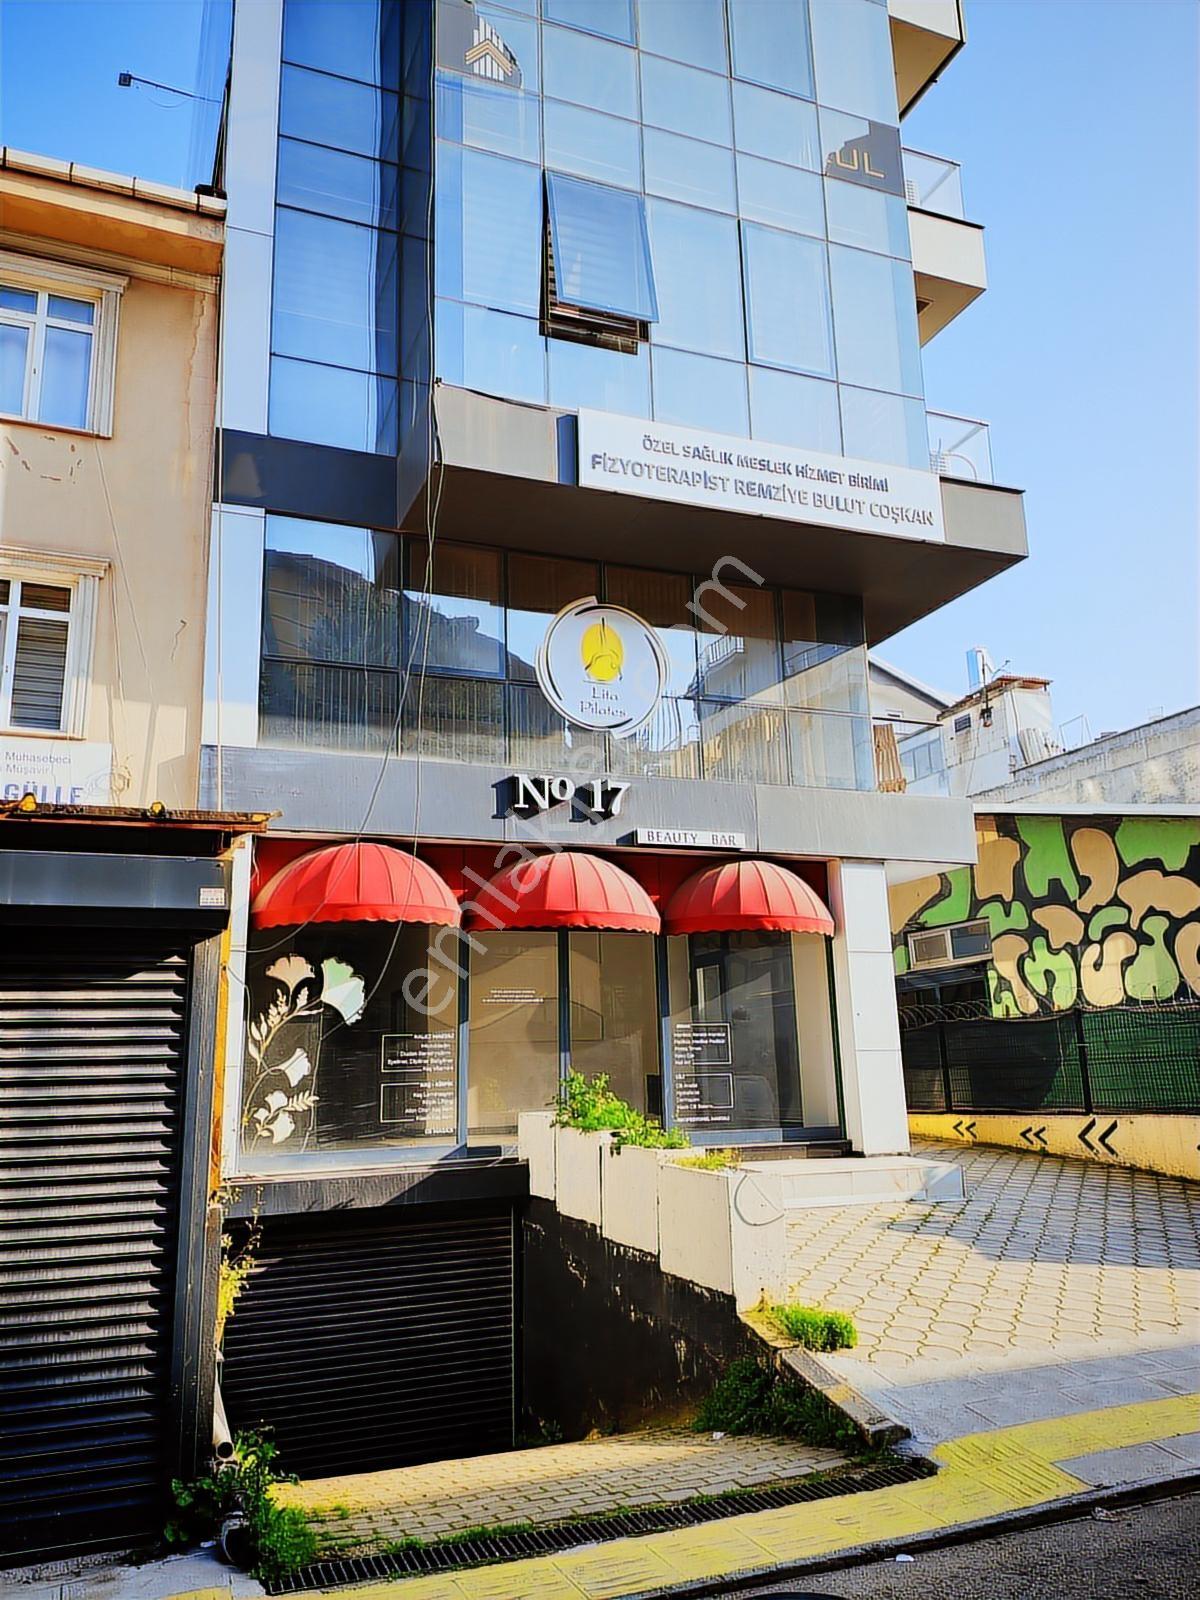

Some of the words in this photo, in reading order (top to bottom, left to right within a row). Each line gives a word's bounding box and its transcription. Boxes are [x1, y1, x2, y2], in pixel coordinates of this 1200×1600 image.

[642, 434, 680, 456] ÖZEL
[682, 445, 734, 466] SAĞLIK
[736, 454, 791, 475] MESLEK
[795, 463, 845, 484] HİZMET
[848, 472, 889, 493] BİRİMİ
[591, 452, 730, 492] FİZYOTERAPİST
[735, 478, 808, 506] REMZİYE
[813, 491, 865, 515] BULUT
[870, 502, 934, 526] COŞKAN
[580, 700, 627, 718] Pilates
[647, 830, 699, 845] BEAUTY
[711, 832, 737, 846] BAR
